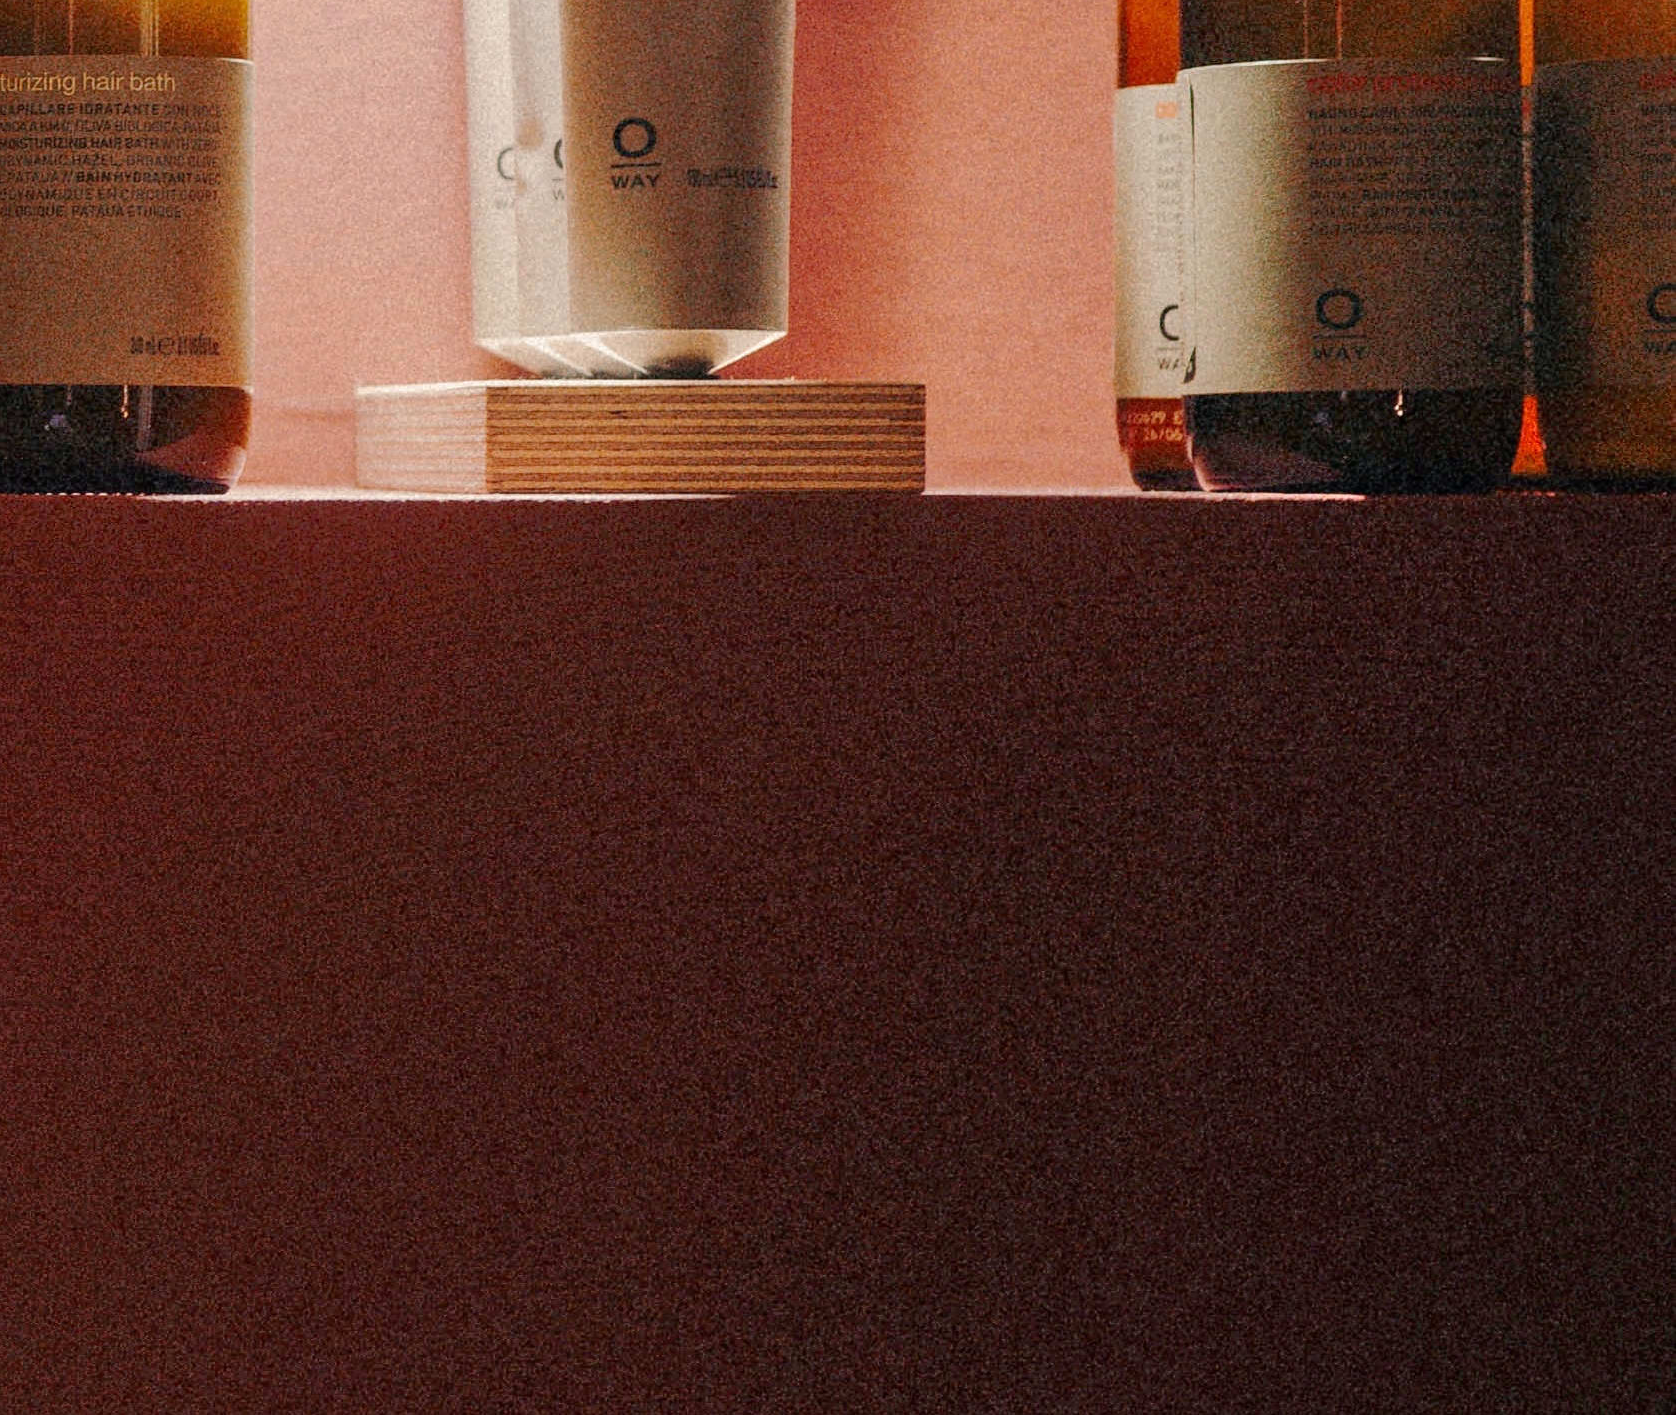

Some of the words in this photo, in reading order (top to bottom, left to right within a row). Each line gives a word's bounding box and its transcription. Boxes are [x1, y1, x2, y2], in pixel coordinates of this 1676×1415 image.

[82, 71, 124, 91] hair
[129, 71, 176, 91] bath
[80, 103, 160, 115] IDRATANTE
[612, 117, 657, 159] O
[611, 174, 660, 190] WAY
[1315, 288, 1364, 330] O
